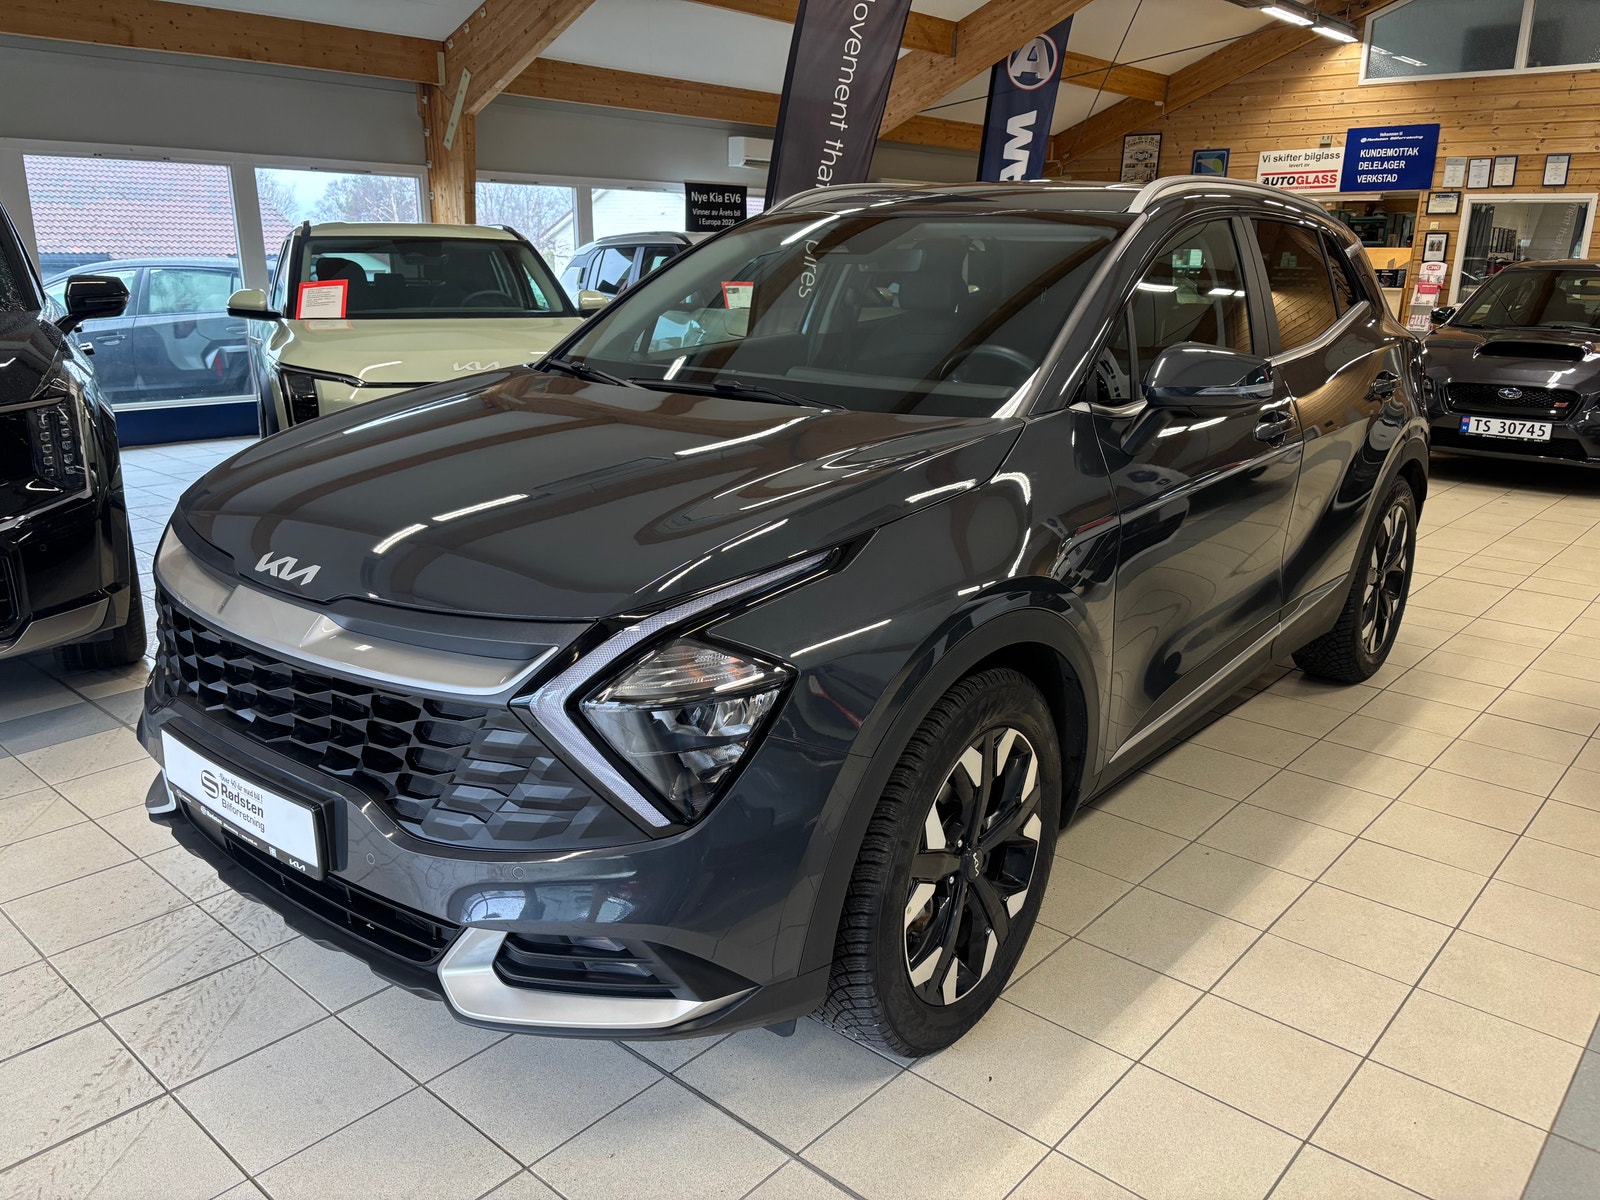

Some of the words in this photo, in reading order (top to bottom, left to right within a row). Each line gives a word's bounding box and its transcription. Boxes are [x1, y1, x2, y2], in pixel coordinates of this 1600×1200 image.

[829, 0, 876, 132] ovement
[1262, 154, 1271, 163] Vi
[1273, 153, 1302, 163] skifter
[1304, 152, 1341, 162] bilglass
[1360, 147, 1420, 158] KUNDEMOTTAK
[1358, 160, 1406, 170] DELELAGER
[1262, 174, 1338, 186] AUTOGLASS
[1357, 173, 1398, 183] VERKSTAD
[690, 191, 708, 204] Nye
[709, 192, 723, 203] Kia
[724, 193, 742, 203] EV6
[692, 208, 711, 216] Vinner
[719, 207, 733, 217] Årets
[733, 209, 741, 217] bil
[702, 218, 721, 227] Europa
[722, 218, 736, 226] 2022
[1474, 418, 1492, 433] TS
[1497, 421, 1547, 437] 30745
[220, 782, 264, 819] Rødsten
[221, 798, 265, 834] Bilforretning
